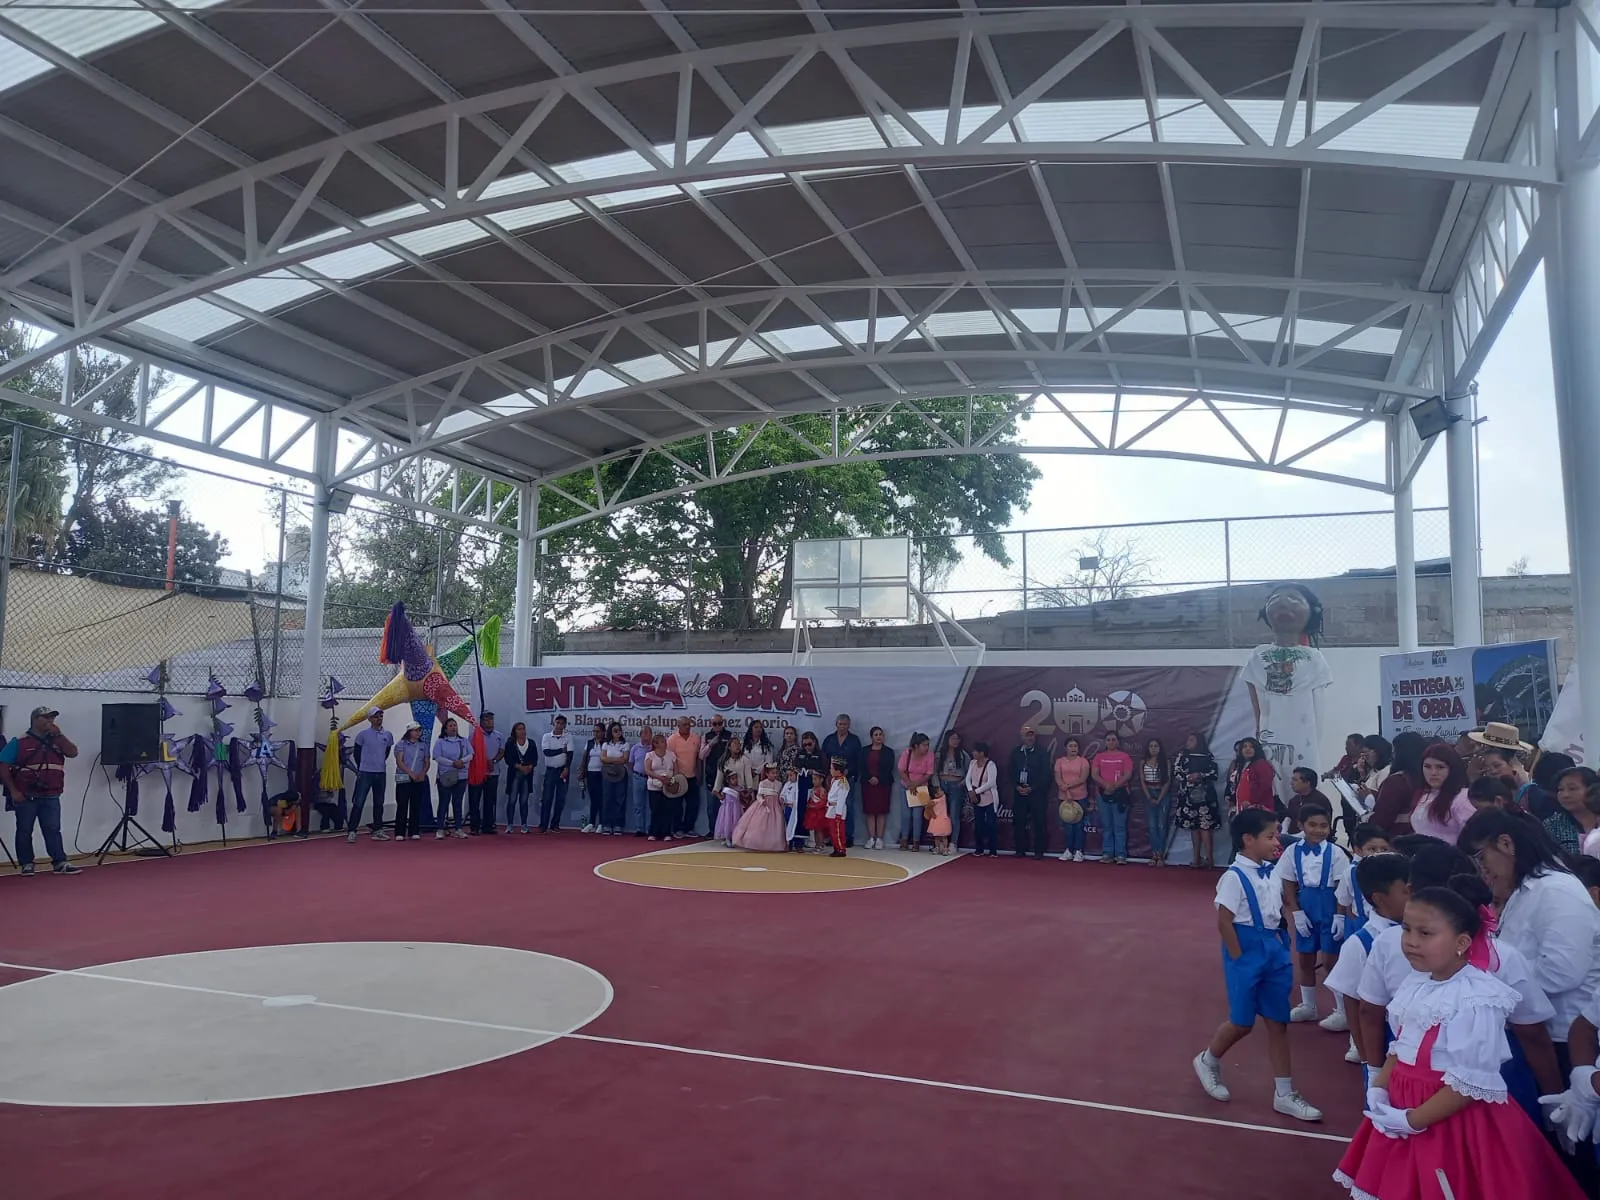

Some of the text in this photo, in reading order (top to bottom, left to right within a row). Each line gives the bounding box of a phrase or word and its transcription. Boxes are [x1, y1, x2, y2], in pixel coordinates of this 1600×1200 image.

[525, 672, 821, 716] ENTREGA de OBRA
[1399, 676, 1455, 697] ENTREGA
[1392, 696, 1468, 721] DE OBRA
[618, 714, 681, 731] Guadalup
[744, 716, 789, 728] Oorio
